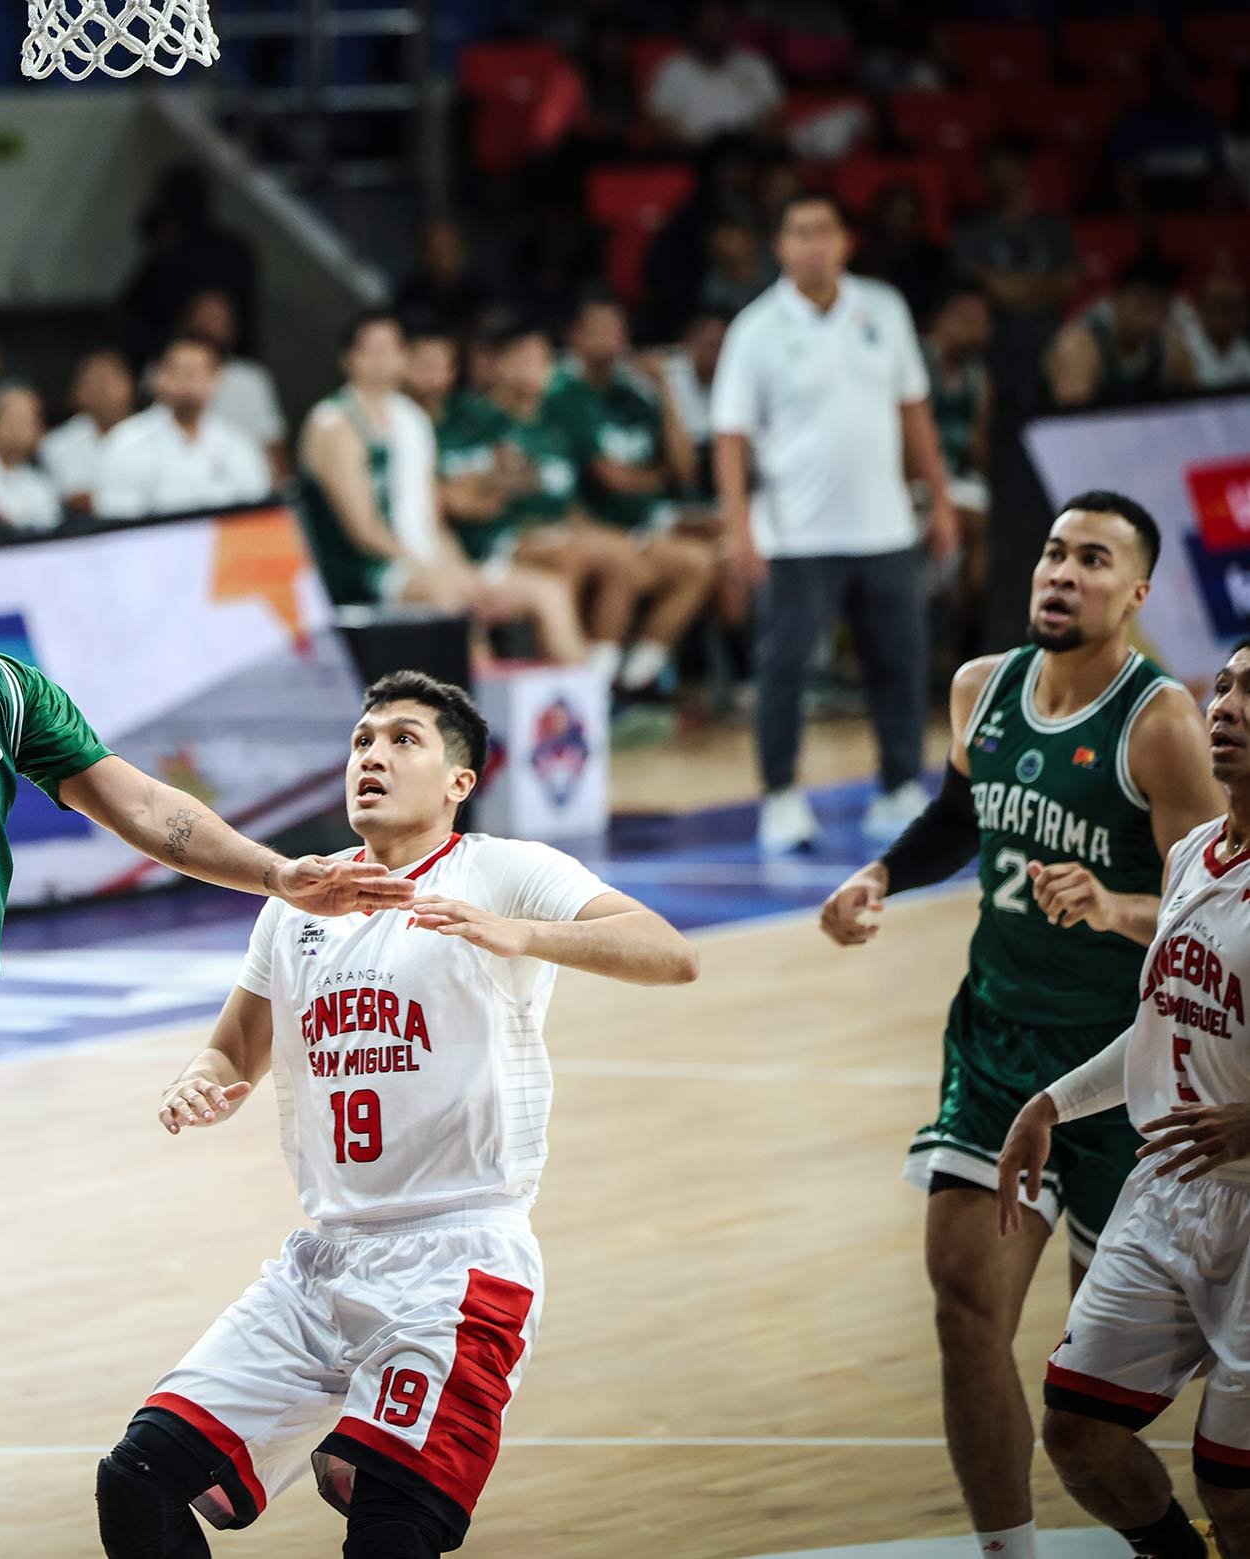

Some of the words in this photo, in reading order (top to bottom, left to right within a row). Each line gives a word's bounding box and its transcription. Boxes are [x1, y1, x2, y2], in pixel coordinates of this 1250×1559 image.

[301, 929, 326, 937] ORLD
[308, 1050, 340, 1078] SAN
[344, 1044, 421, 1077] MIGUEL
[329, 1088, 384, 1164] 19
[373, 1366, 429, 1428] 19
